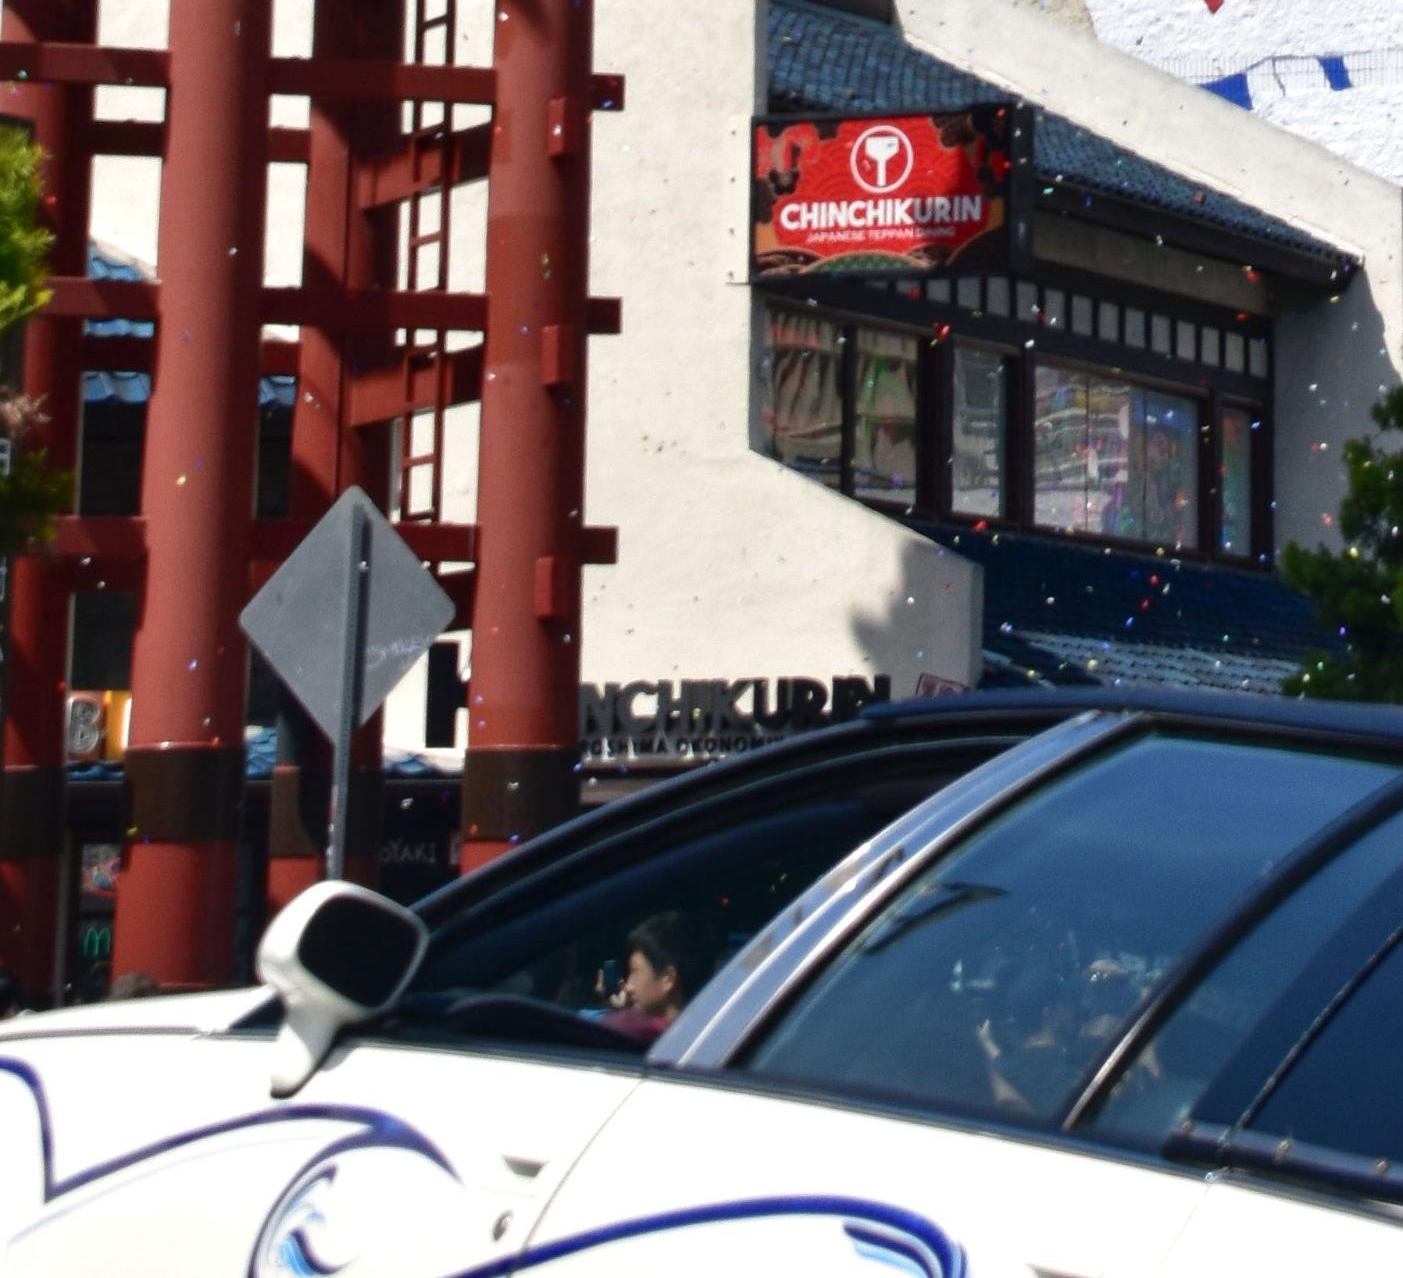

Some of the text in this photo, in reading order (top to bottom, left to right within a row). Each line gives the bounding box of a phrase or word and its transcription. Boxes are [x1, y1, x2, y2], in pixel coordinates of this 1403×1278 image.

[780, 195, 983, 231] CHINCHIKURIN
[805, 229, 867, 244] JAPANESE
[867, 227, 914, 242] TEPPAN
[580, 675, 891, 737] NCHIKURIN
